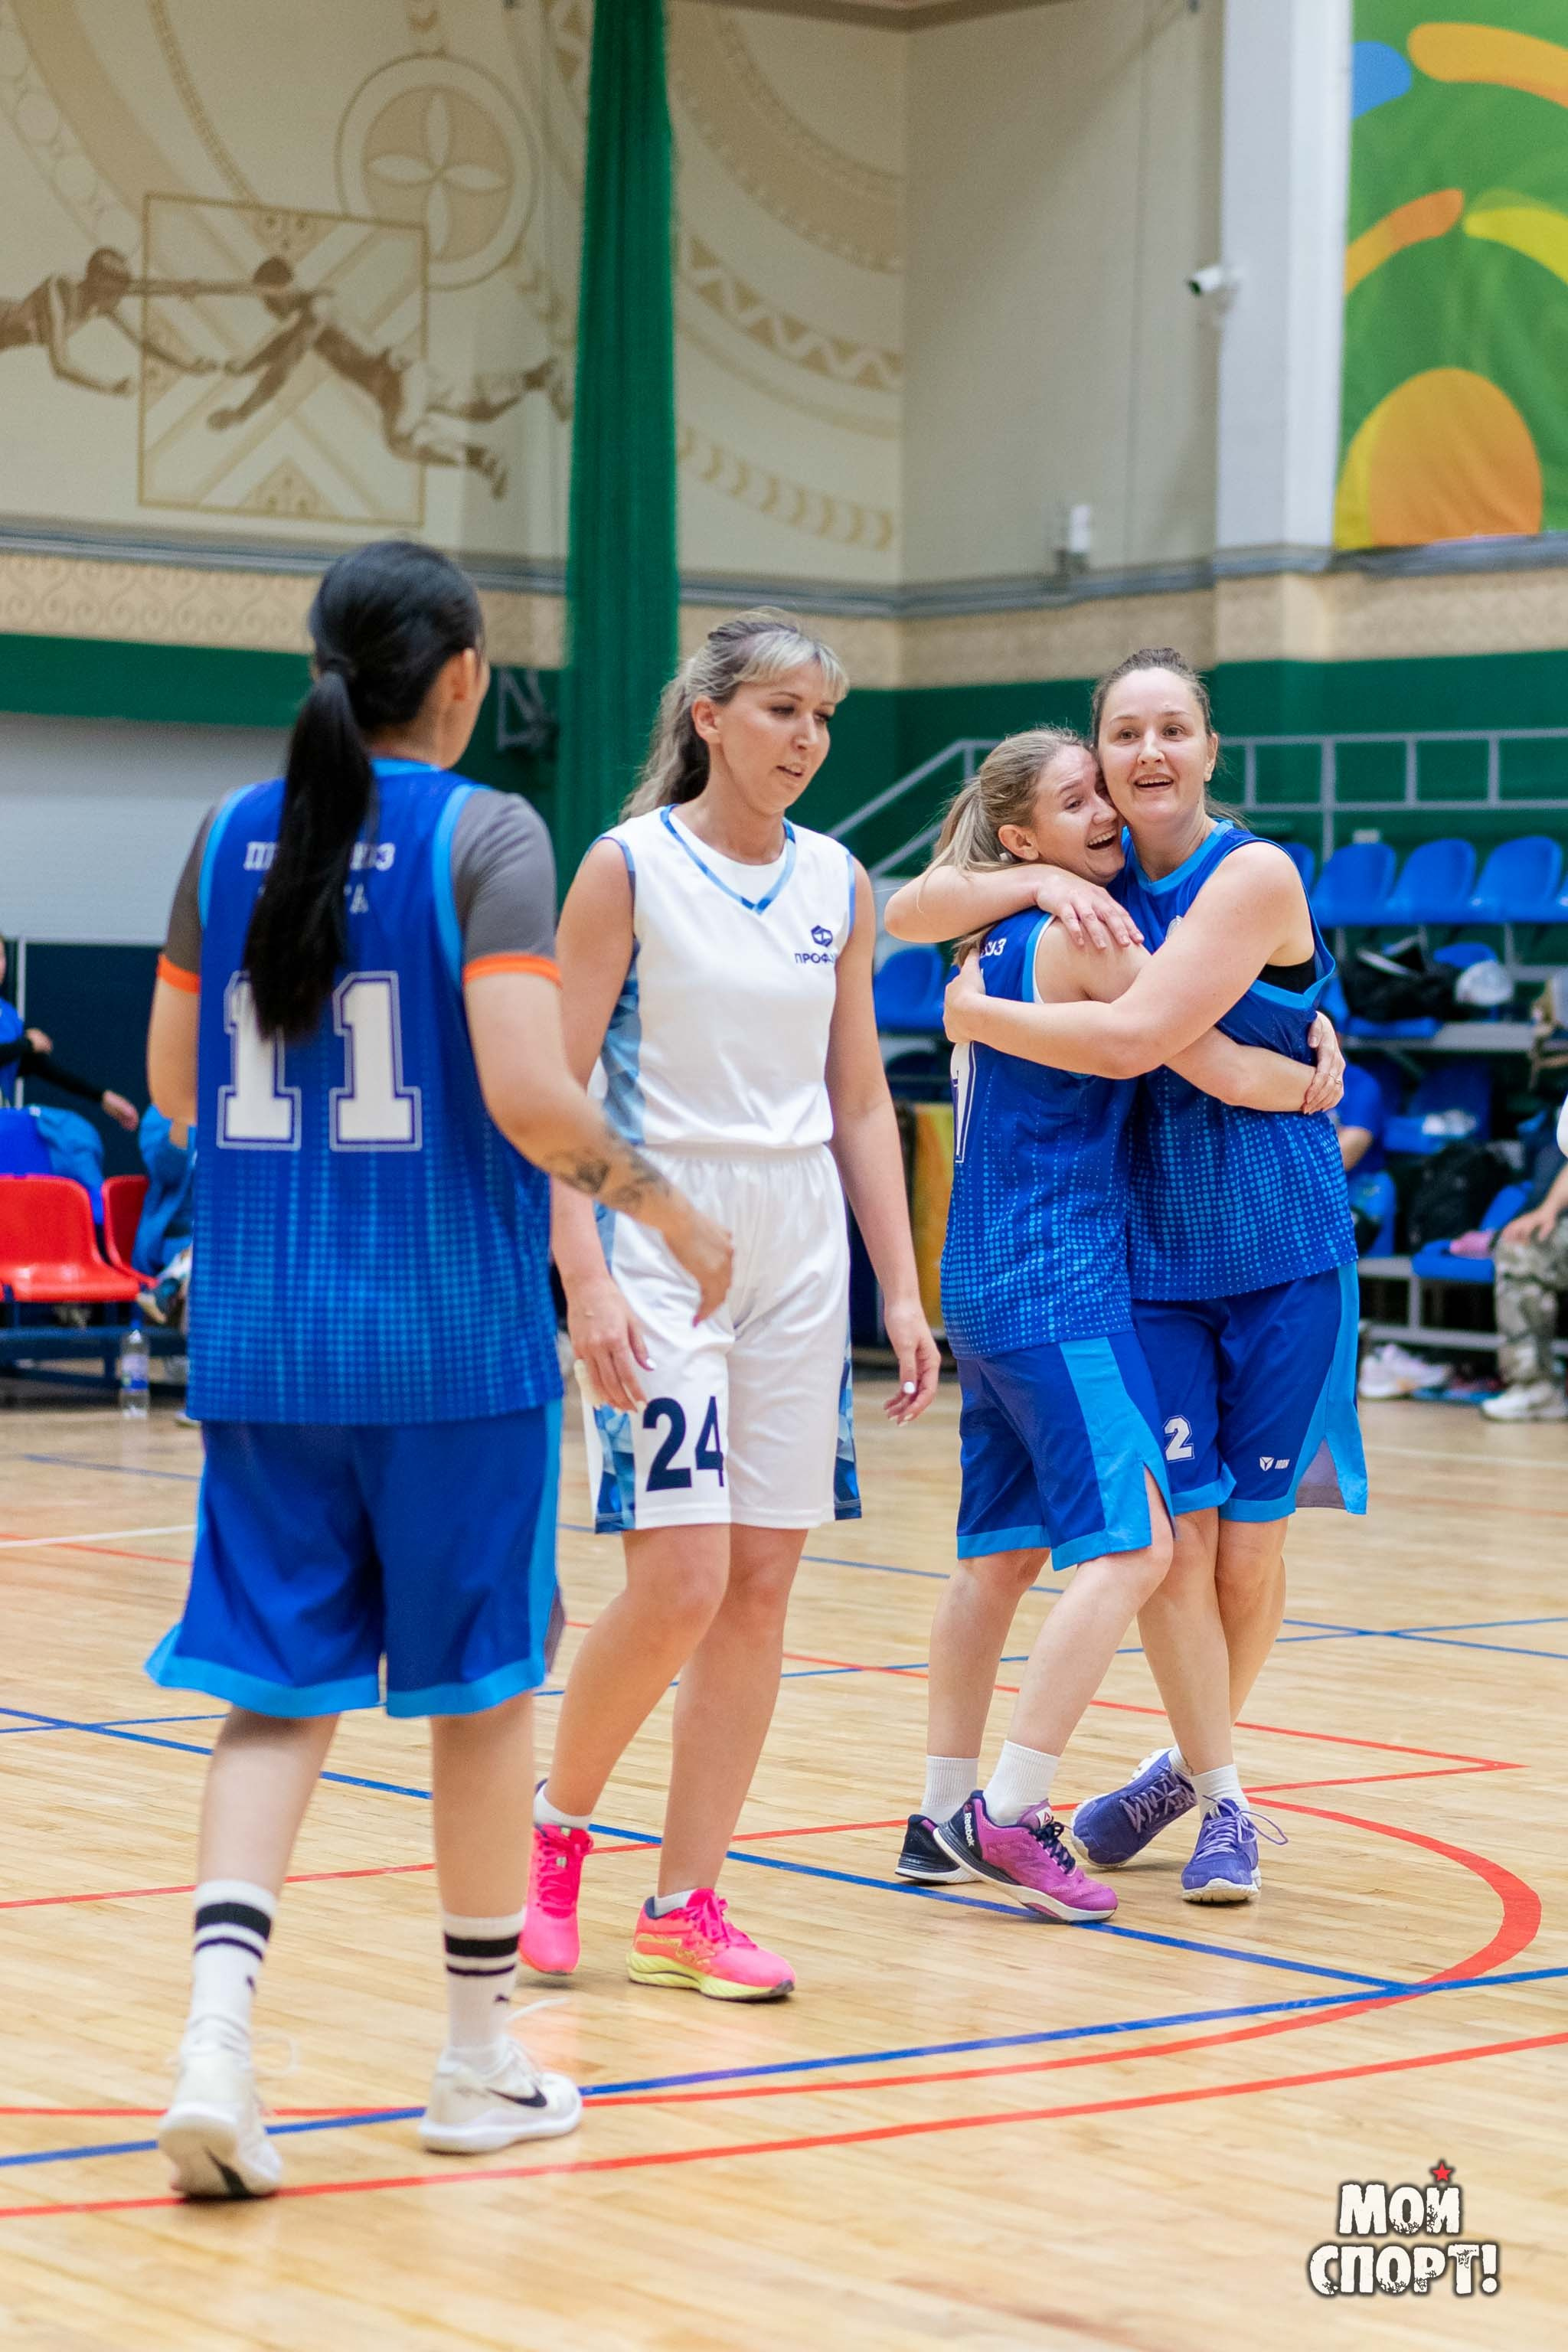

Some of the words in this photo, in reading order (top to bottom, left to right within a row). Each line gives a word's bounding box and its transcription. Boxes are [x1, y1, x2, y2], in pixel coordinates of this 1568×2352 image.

[795, 952, 835, 964] ПРОФ
[217, 971, 422, 1152] 11
[642, 1396, 724, 1492] 24
[1163, 1415, 1195, 1463] 2
[965, 1812, 975, 1847] Reebok
